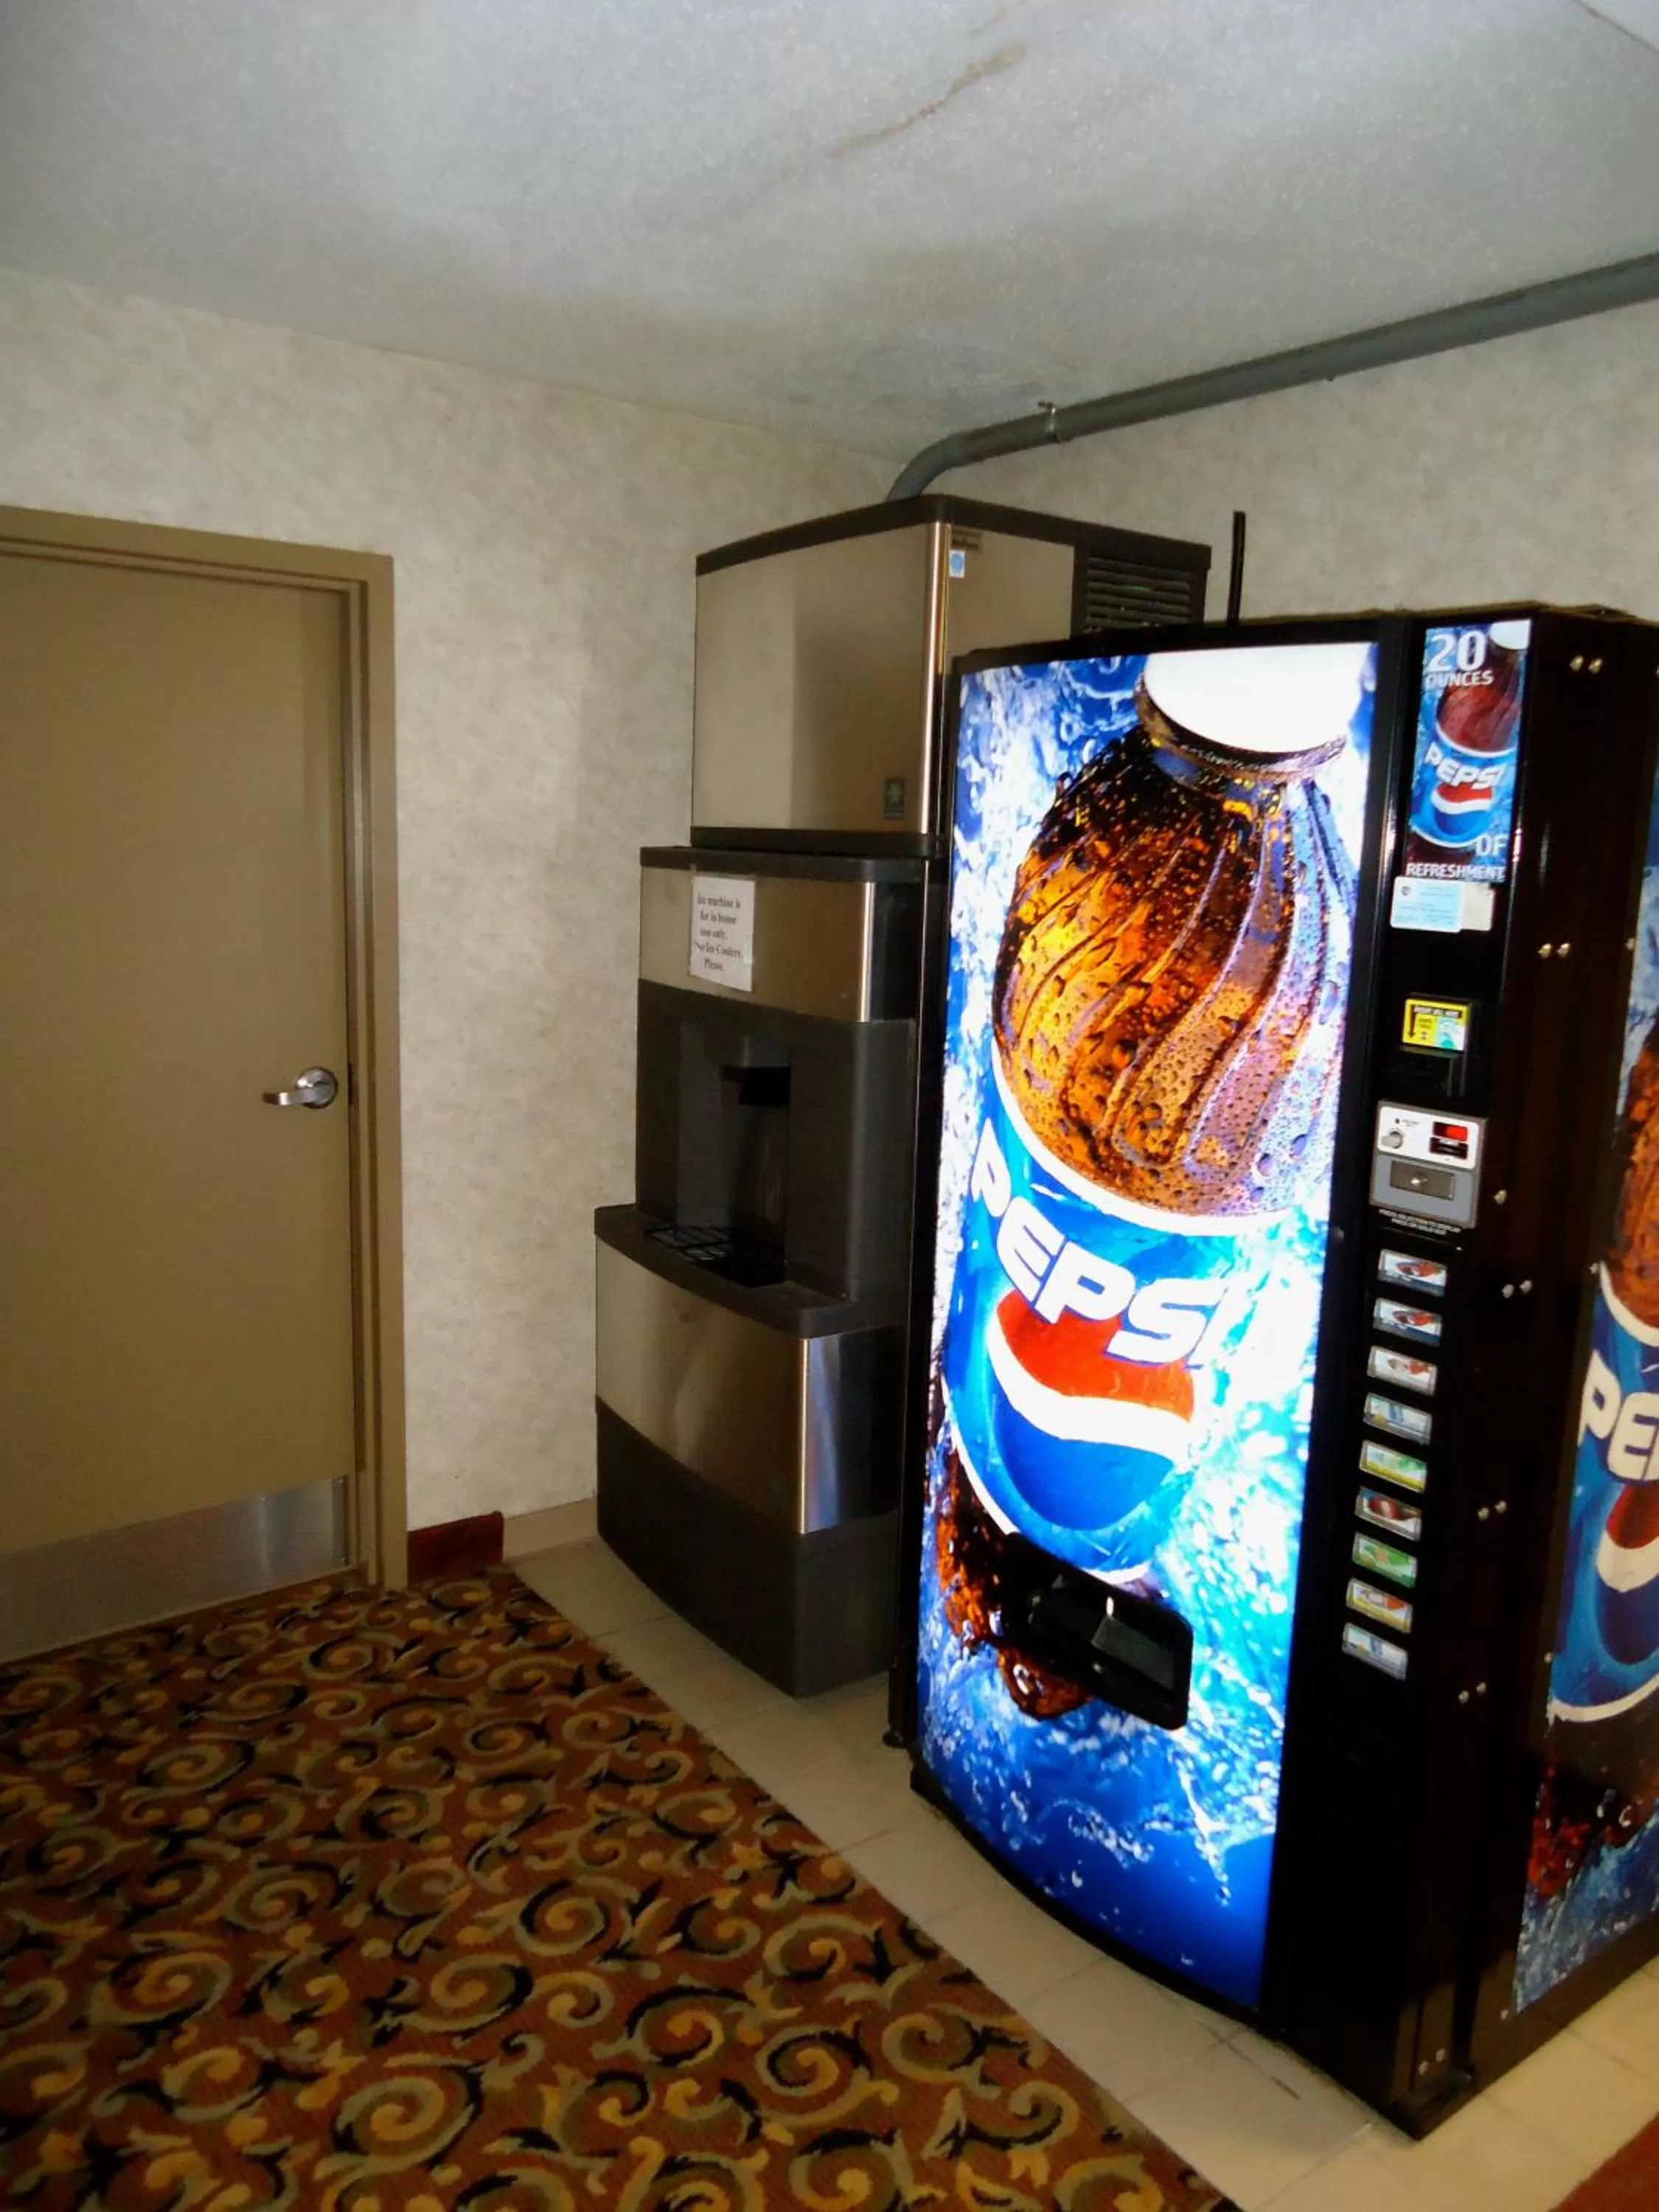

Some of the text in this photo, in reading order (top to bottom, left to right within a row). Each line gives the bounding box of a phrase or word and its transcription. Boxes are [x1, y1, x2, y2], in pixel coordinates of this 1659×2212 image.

[1427, 630, 1486, 672] 20
[1425, 669, 1494, 689] OUNCES
[1425, 741, 1507, 790] PEPSI
[1476, 833, 1509, 856] OF
[1406, 862, 1506, 883] REFRESHMENT
[970, 1118, 1251, 1369] PEPSI
